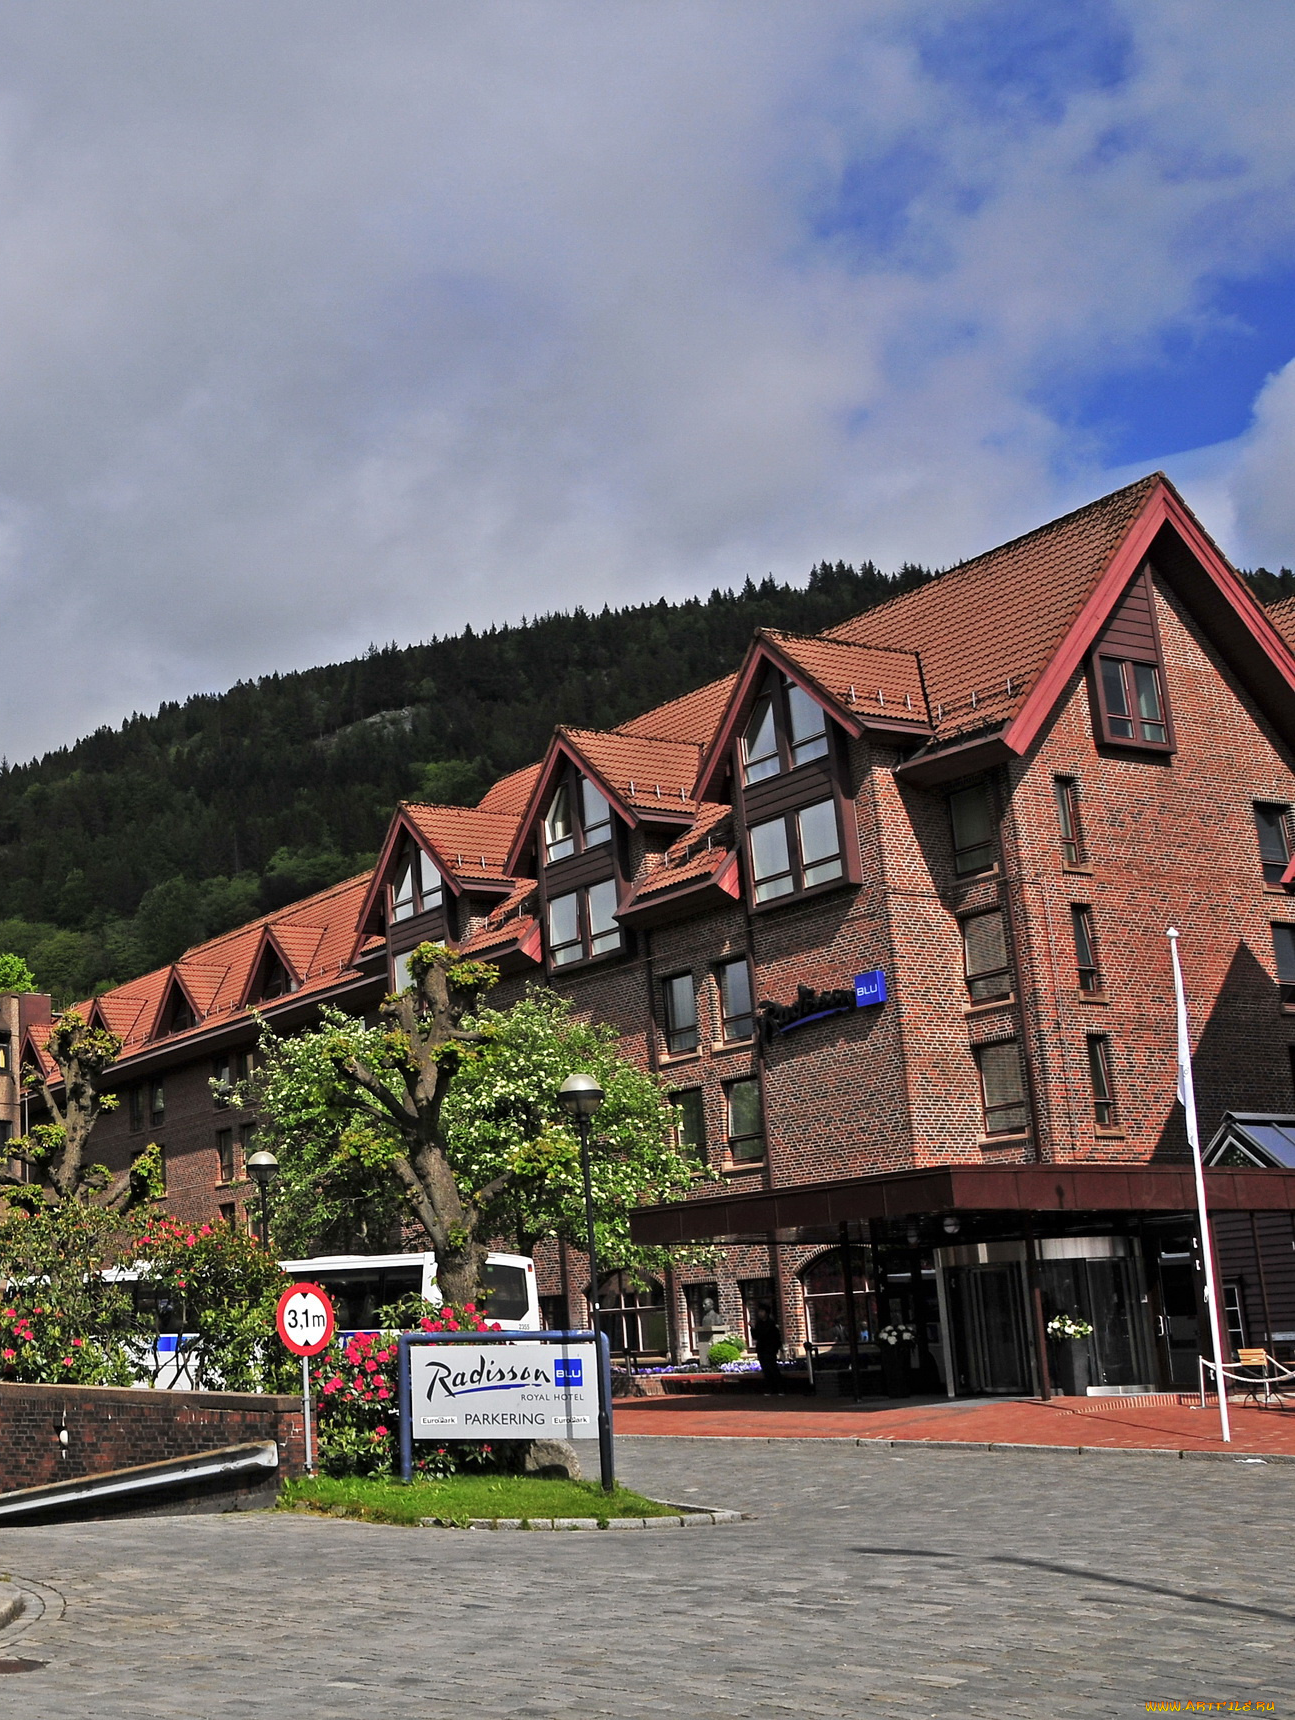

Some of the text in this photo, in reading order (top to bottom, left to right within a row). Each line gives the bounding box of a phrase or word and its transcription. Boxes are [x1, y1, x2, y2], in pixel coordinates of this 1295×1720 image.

[856, 983, 878, 997] BLU
[424, 1354, 581, 1403] Radisson BLU
[520, 1393, 584, 1402] ROYAL HOTEL
[464, 1412, 546, 1426] PARKERING
